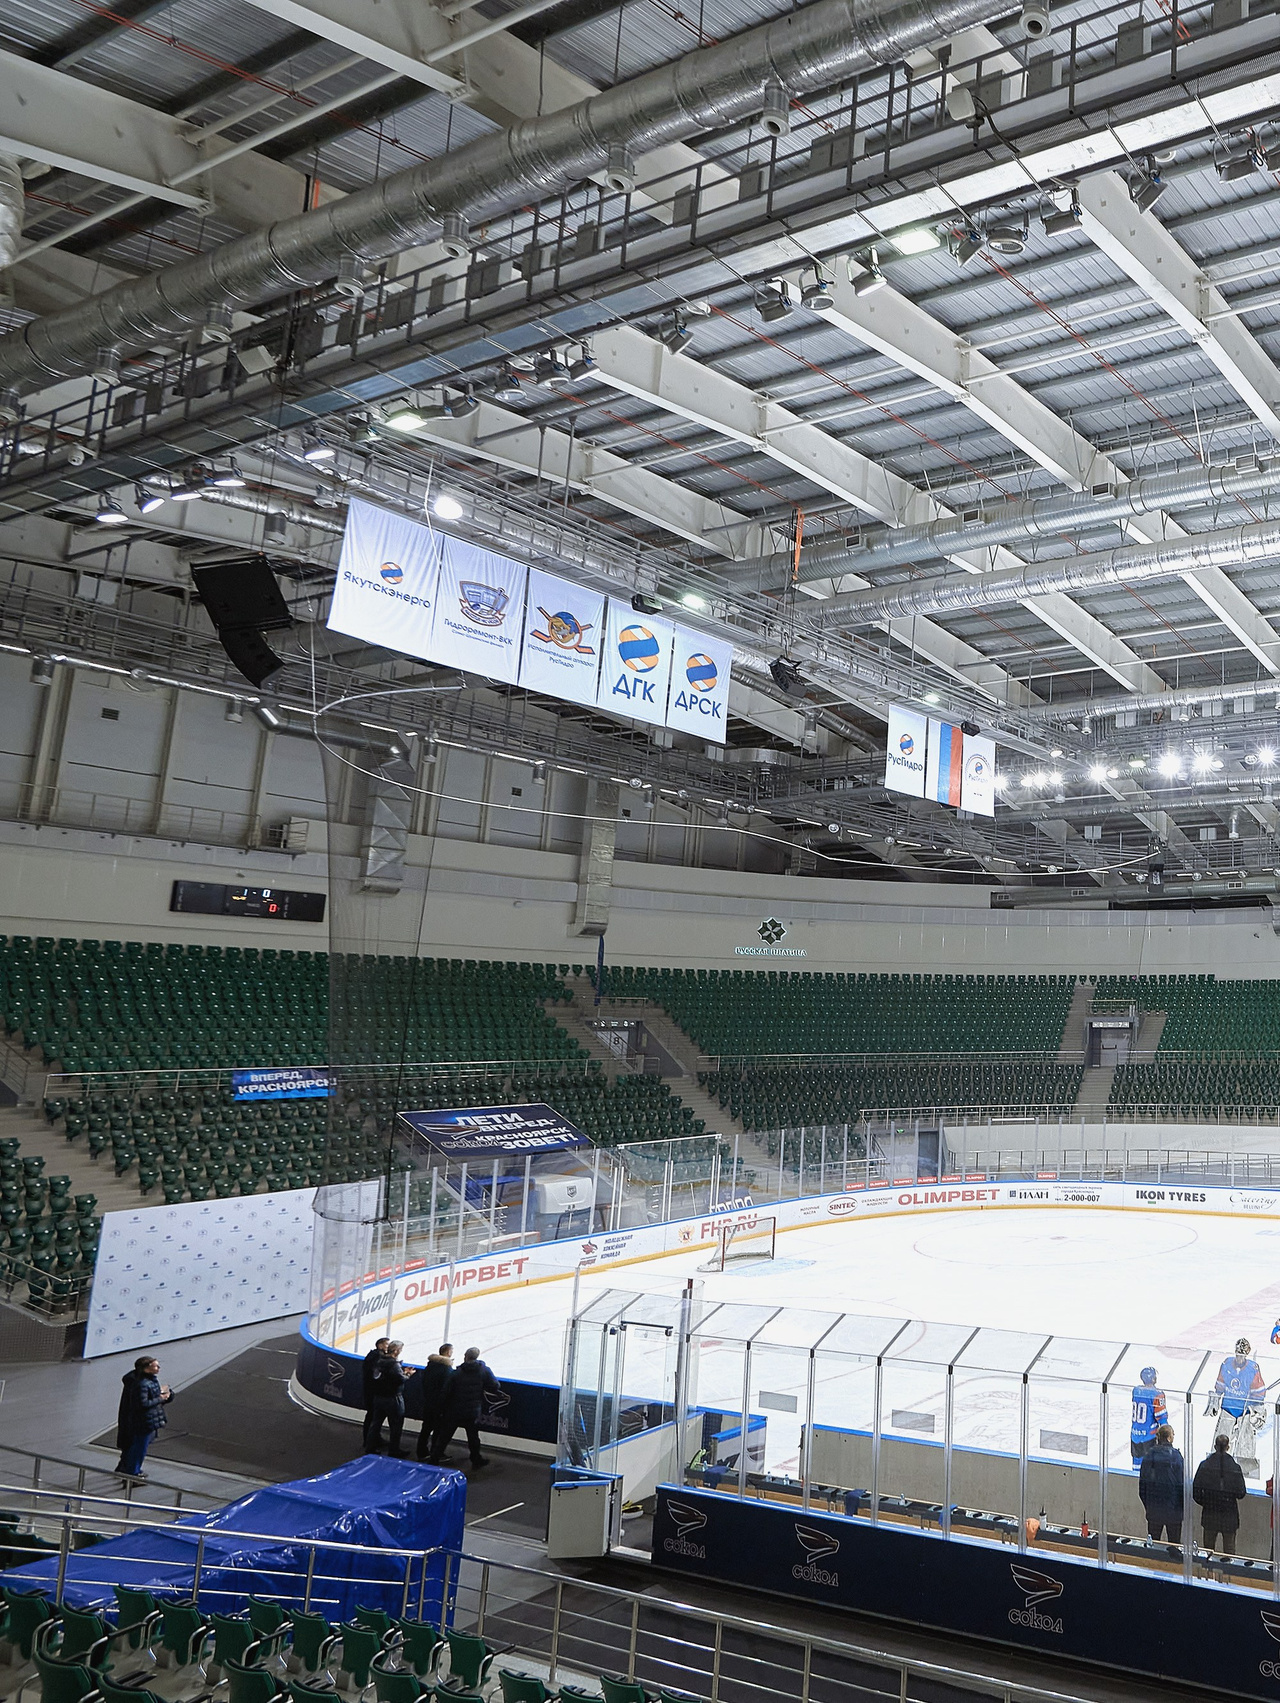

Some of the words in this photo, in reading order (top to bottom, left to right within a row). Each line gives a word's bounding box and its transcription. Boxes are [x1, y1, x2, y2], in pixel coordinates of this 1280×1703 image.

[343, 570, 431, 609] Якутскэнерго
[612, 673, 656, 704] ДГК
[674, 690, 722, 719] ДРСК
[888, 752, 923, 772] РусГидро
[250, 1070, 303, 1082] ВПЕРЕД,
[455, 1112, 525, 1126] ЛЕТИ
[475, 1126, 572, 1143] КРАСНОЯРСК
[501, 1132, 579, 1150] ЗОВЕТ!
[897, 1189, 1000, 1206] OLIMPBET
[1064, 1194, 1100, 1202] 2-000-007
[1135, 1190, 1165, 1201] IKON
[1169, 1192, 1207, 1203] TYRES
[829, 1201, 856, 1211] SINTEC
[403, 1257, 530, 1301] OLIMPBET
